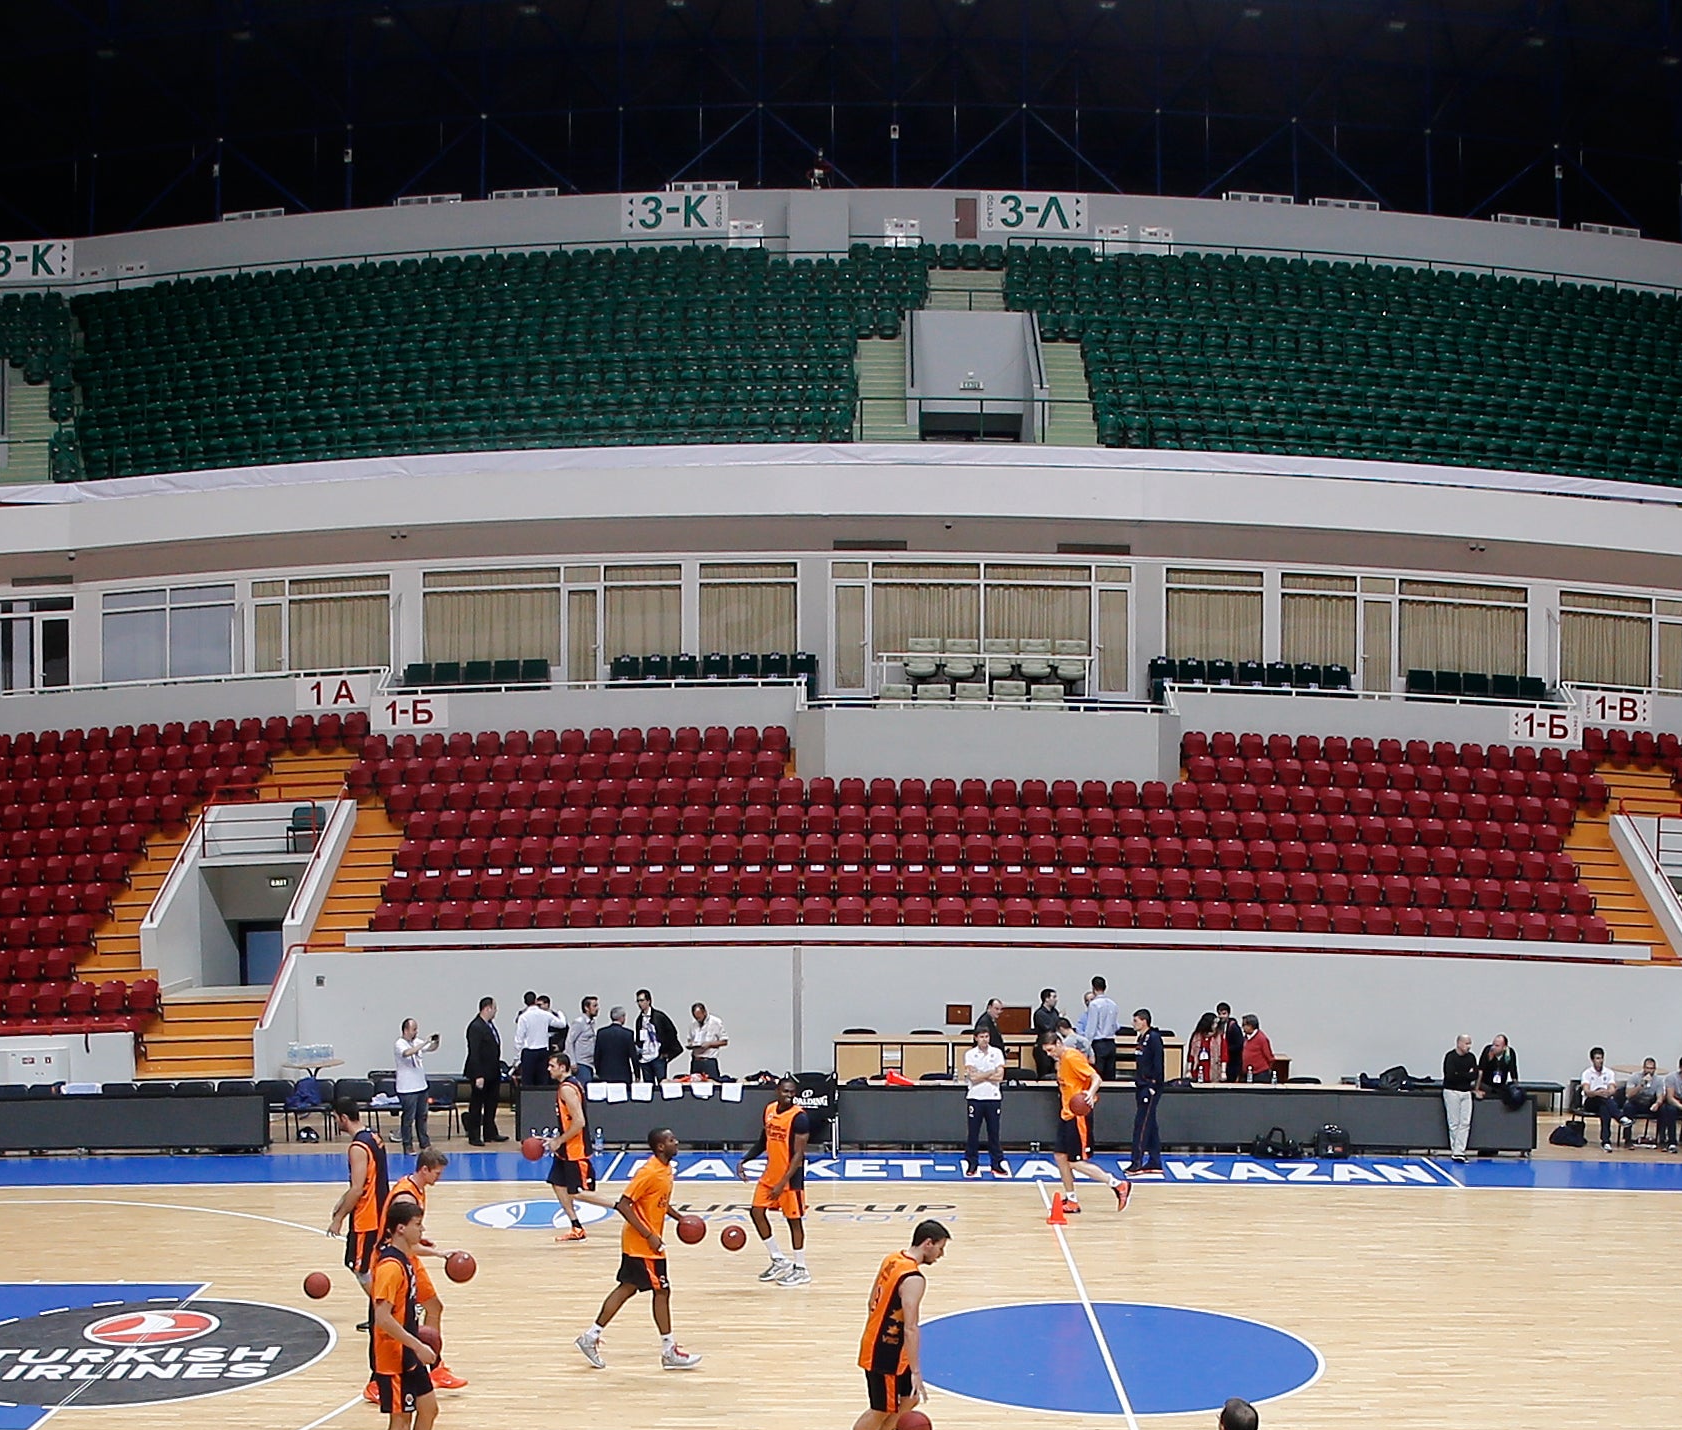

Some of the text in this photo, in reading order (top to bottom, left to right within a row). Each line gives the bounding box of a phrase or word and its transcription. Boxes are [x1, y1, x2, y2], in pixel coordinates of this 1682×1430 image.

[639, 194, 708, 229] 3-К
[1000, 194, 1069, 230] 3-Л
[310, 681, 322, 706] 1
[385, 699, 434, 726] 1-Б
[1595, 695, 1638, 722] 1-В
[1523, 712, 1569, 740] 1-Б
[792, 1095, 829, 1107] PALDING
[1165, 1160, 1441, 1184] KAZAN
